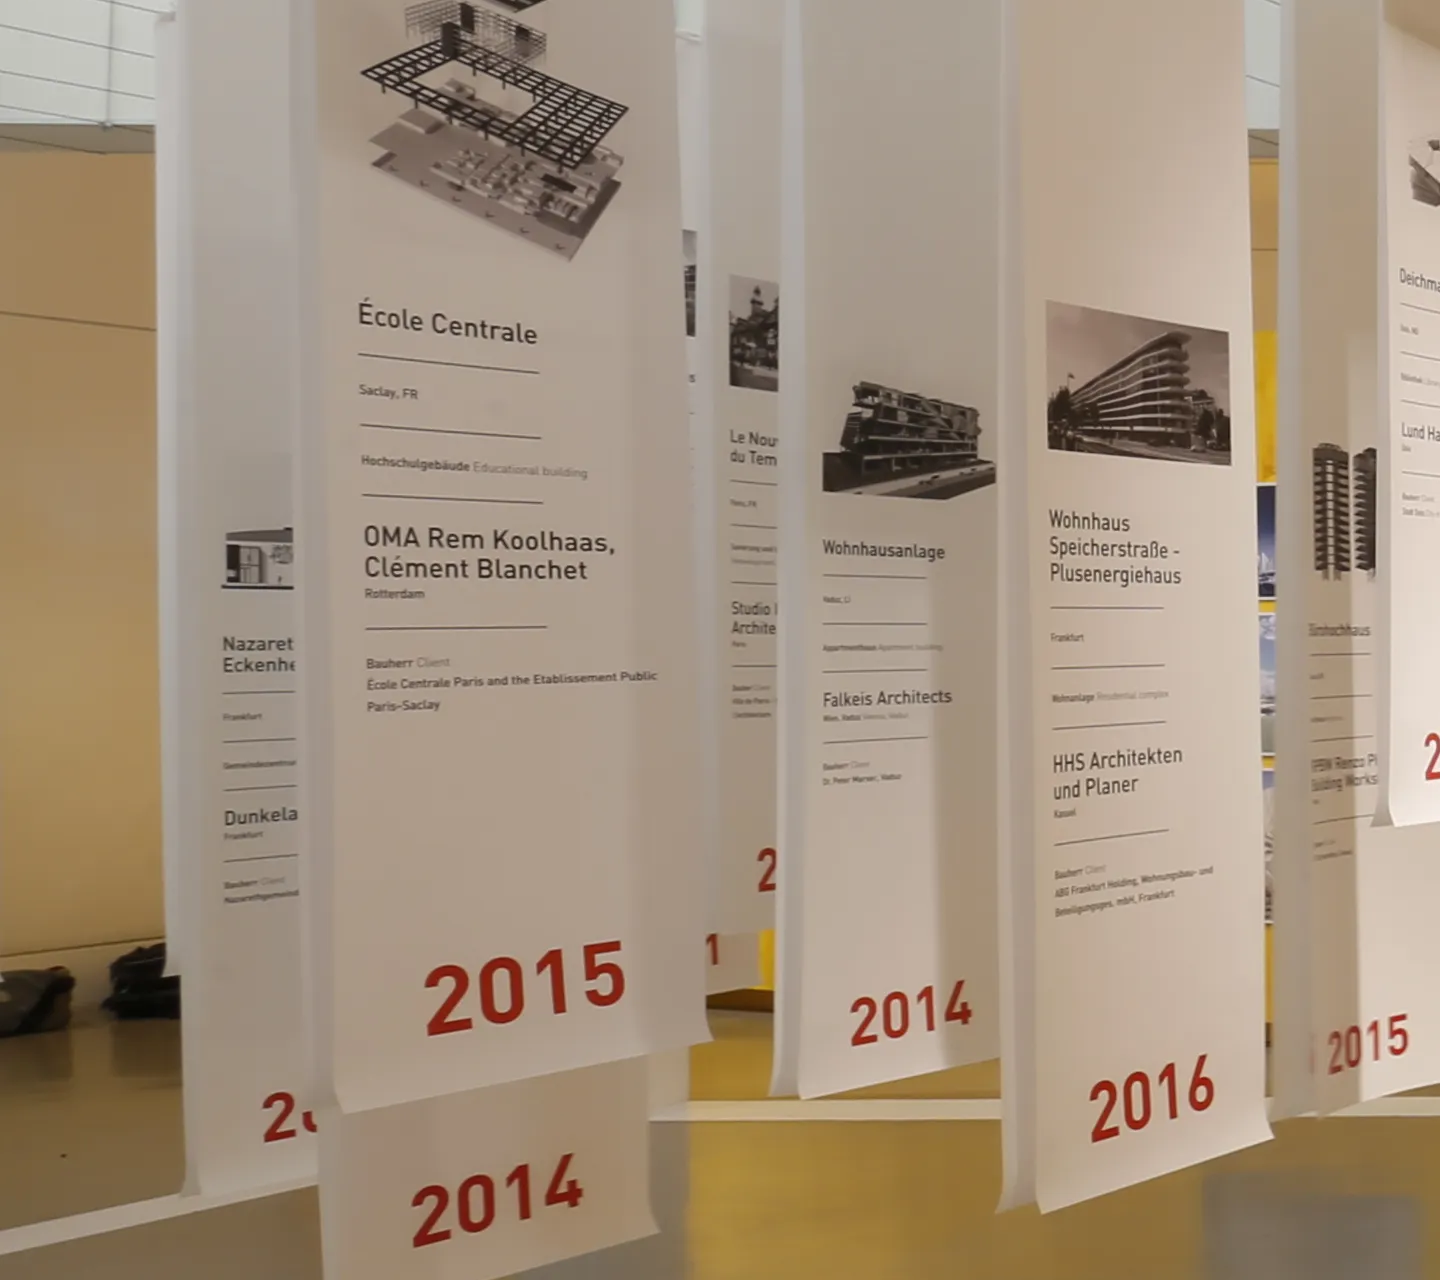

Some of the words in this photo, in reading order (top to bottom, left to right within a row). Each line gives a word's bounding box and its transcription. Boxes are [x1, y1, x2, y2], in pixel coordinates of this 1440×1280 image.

[358, 296, 425, 332] École
[431, 312, 540, 345] Centrale
[358, 383, 401, 400] Saclay,
[402, 387, 418, 400] FR
[730, 429, 746, 444] Le
[1401, 421, 1426, 440] Lund
[361, 454, 470, 472] Hochschulgebäude
[473, 461, 539, 476] Educational
[541, 465, 588, 481] building
[730, 449, 746, 463] du
[1048, 508, 1131, 532] Wohnhaus
[363, 524, 421, 549] OMA
[428, 526, 485, 550] Rem
[493, 528, 615, 556] Koolhaas,
[822, 538, 946, 563] Wohnhausanlage
[1049, 536, 1169, 560] Speicherstraße
[365, 555, 470, 579] Clément
[477, 557, 589, 580] Blanchet
[1050, 562, 1182, 588] Plusenergiehaus
[365, 588, 425, 600] Rotterdam
[731, 601, 771, 616] Studio
[366, 658, 413, 670] Bauherr
[416, 657, 450, 669] Client
[400, 676, 450, 690] Centrale
[453, 676, 485, 689] Paris
[487, 675, 509, 687] and
[511, 674, 531, 686] the
[533, 672, 617, 685] Etablissement
[620, 670, 658, 683] Public
[366, 699, 441, 712] Paris-Saclay
[822, 691, 873, 708] Falkeis
[877, 688, 953, 706] Architects
[1053, 752, 1085, 773] HHS
[1089, 746, 1183, 770] Architekten
[1053, 779, 1081, 800] und
[1085, 777, 1140, 797] Planer
[424, 940, 626, 1037] 2015
[850, 979, 974, 1047] 2014
[1327, 1013, 1409, 1076] 2015
[1089, 1054, 1216, 1145] 2016
[411, 1152, 585, 1249] 2014
